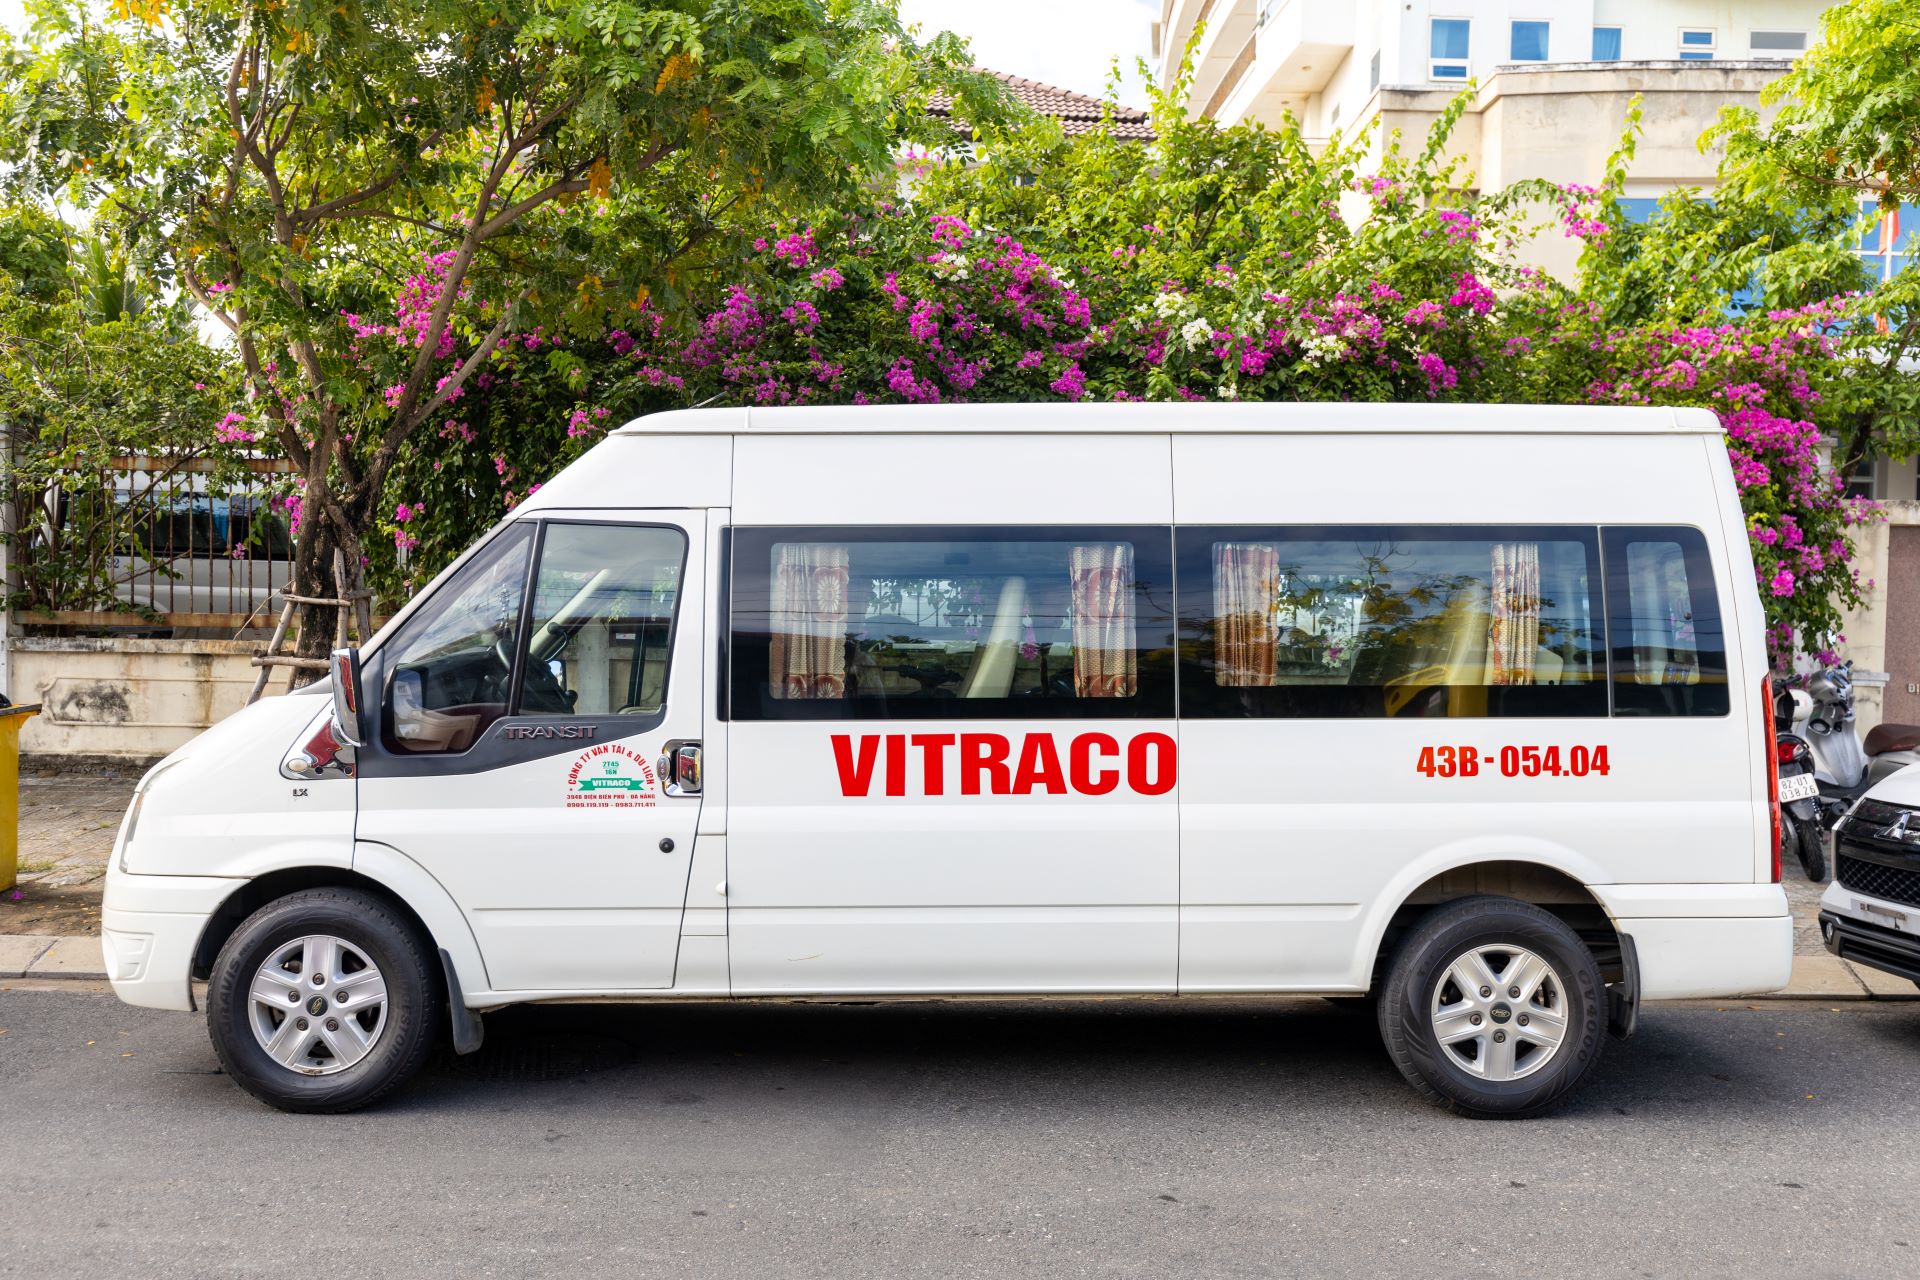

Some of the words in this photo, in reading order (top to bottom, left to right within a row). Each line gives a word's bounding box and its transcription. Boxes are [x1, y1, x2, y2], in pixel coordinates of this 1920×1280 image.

[504, 726, 597, 739] TRANSIT
[580, 752, 591, 763] TY
[633, 754, 647, 766] DU
[830, 731, 1177, 797] VITRACO
[592, 779, 631, 787] VITRACO
[292, 788, 309, 797] LX
